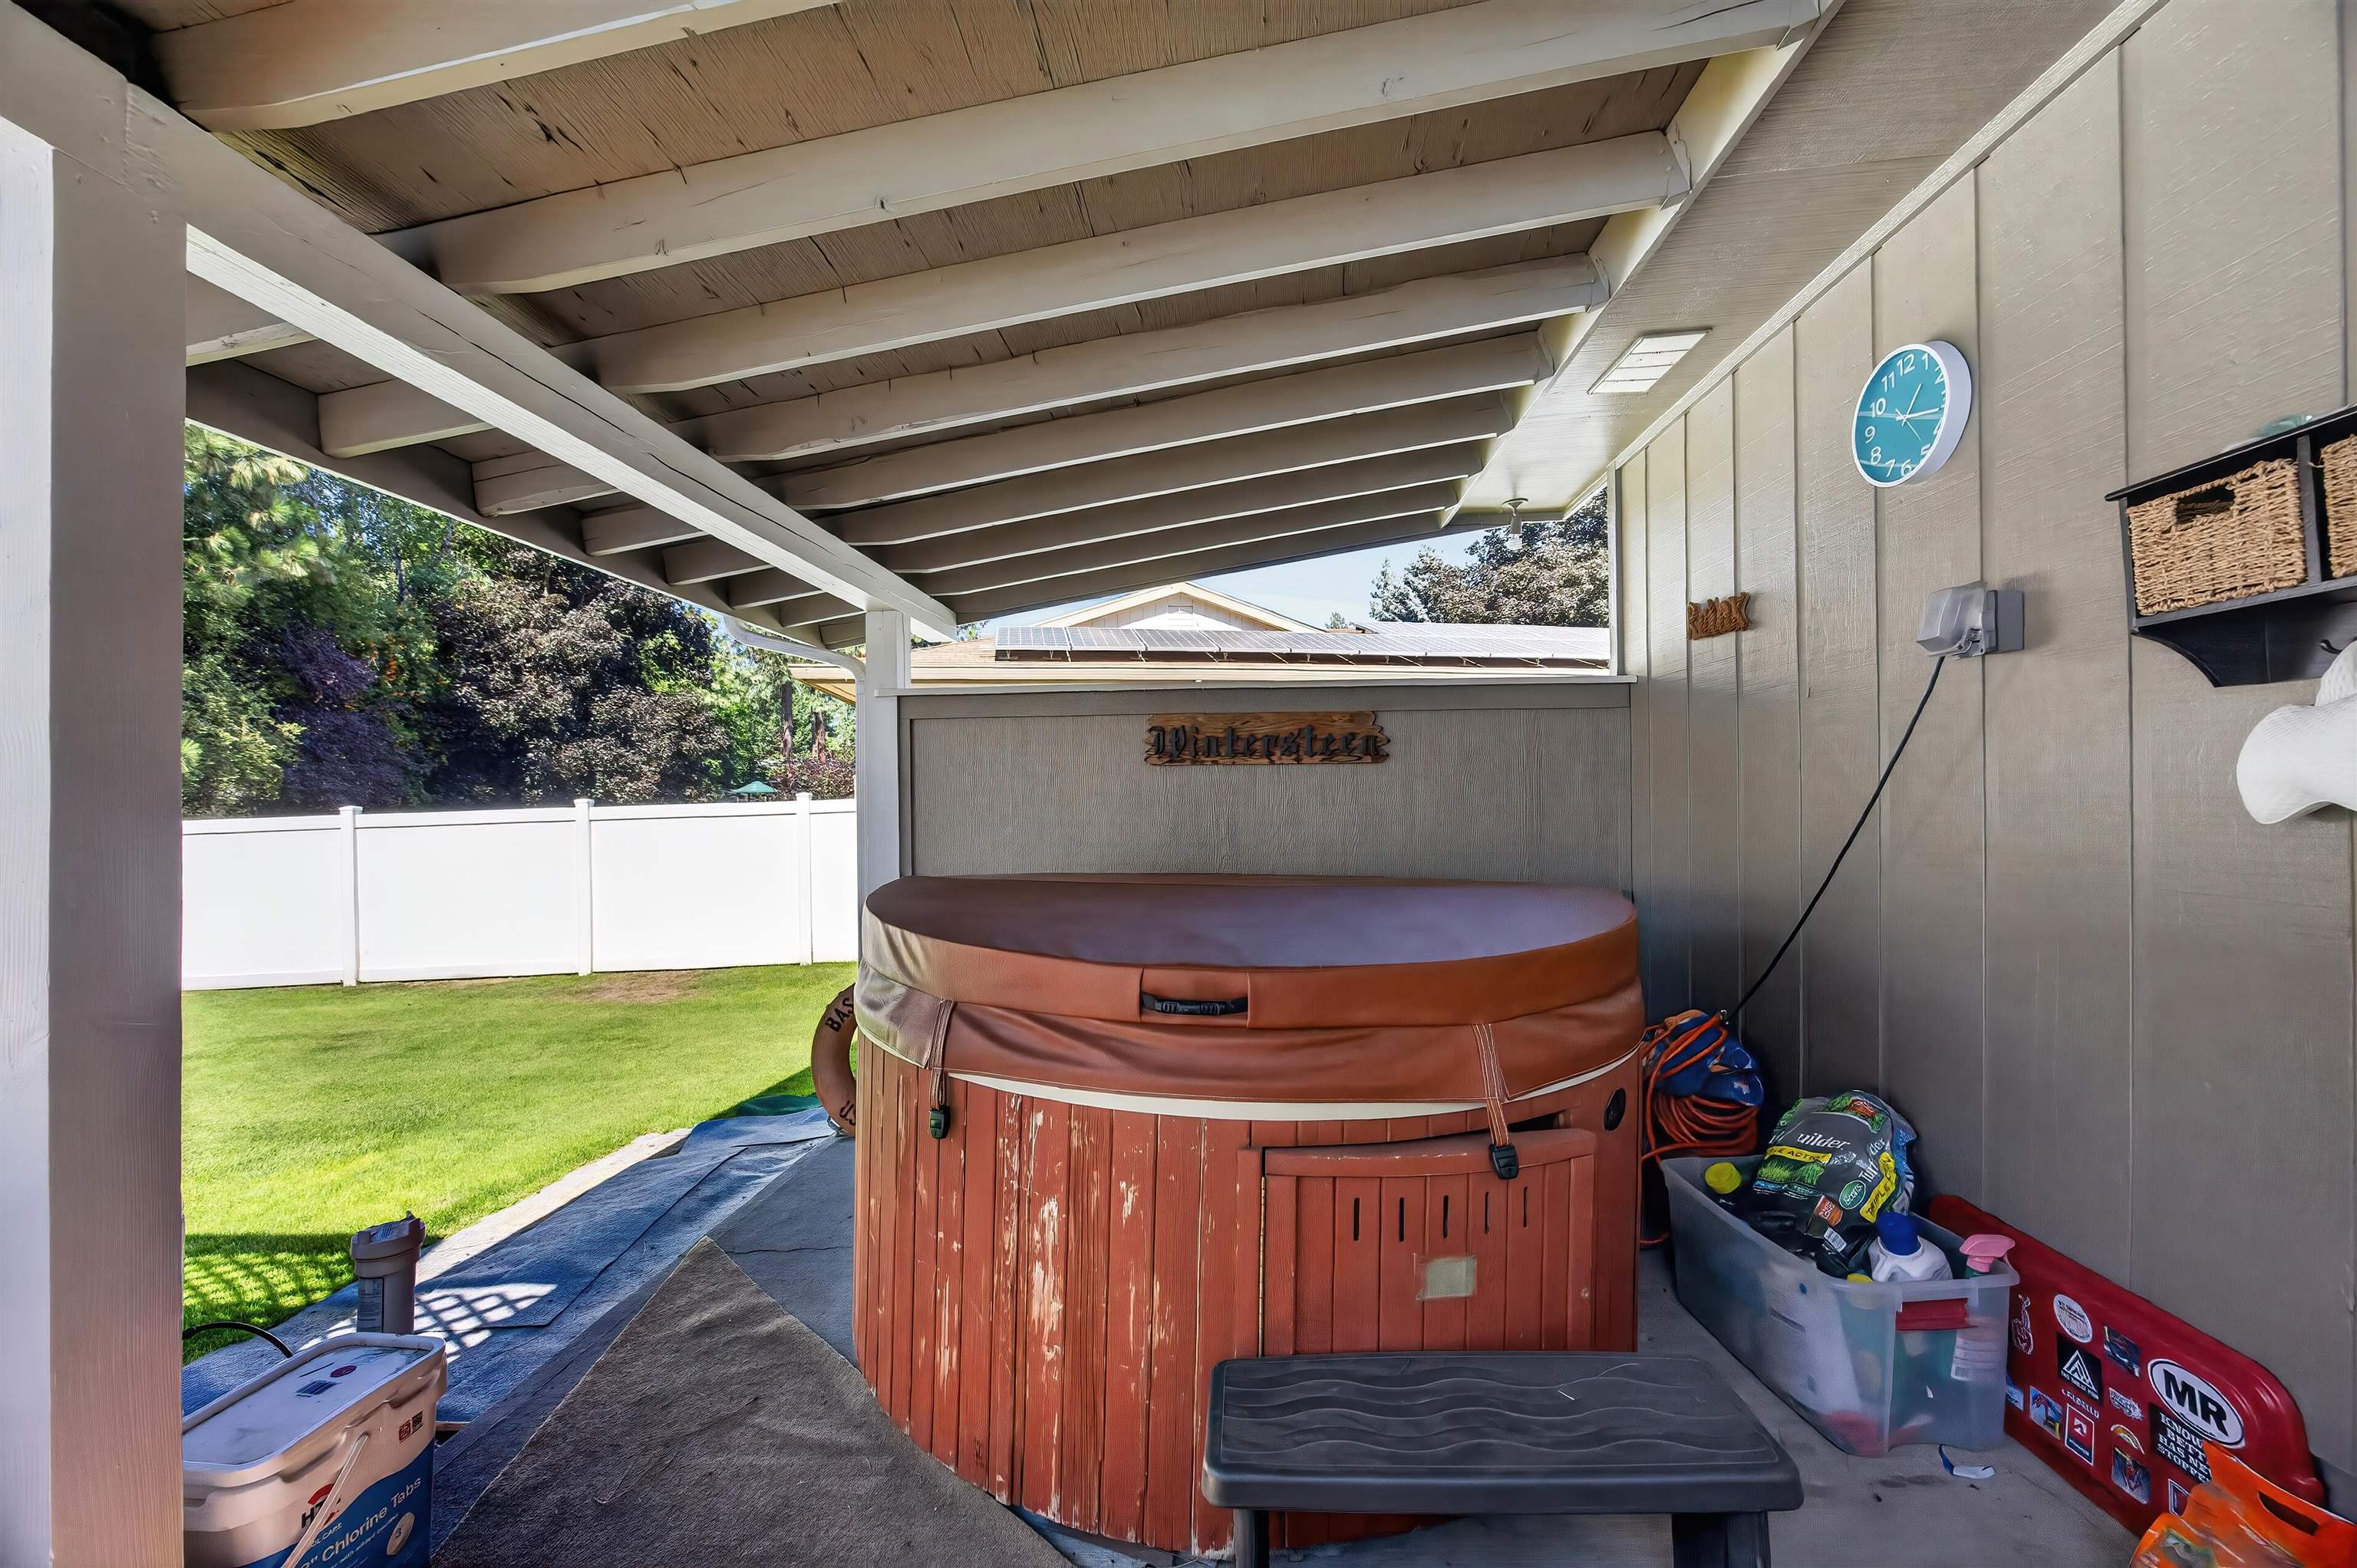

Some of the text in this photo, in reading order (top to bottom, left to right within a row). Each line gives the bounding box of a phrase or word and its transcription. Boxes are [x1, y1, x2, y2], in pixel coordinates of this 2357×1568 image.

[1897, 354, 1915, 376] 12
[1922, 353, 1929, 370] 1
[1881, 371, 1896, 392] 11
[1870, 397, 1886, 418] 10
[1864, 426, 1876, 443] 9
[1870, 446, 1882, 465] 8
[1884, 459, 1896, 477] 7
[1900, 459, 1912, 476] 6
[1148, 724, 1381, 759] Wintersteen
[1797, 1132, 1851, 1150] uilder
[1843, 1184, 1863, 1206] Scotts
[2163, 1369, 2229, 1438] MR
[2158, 1444, 2210, 1483] STOPPE
[321, 1506, 387, 1562] Chlorine
[391, 1477, 421, 1508] Tabs
